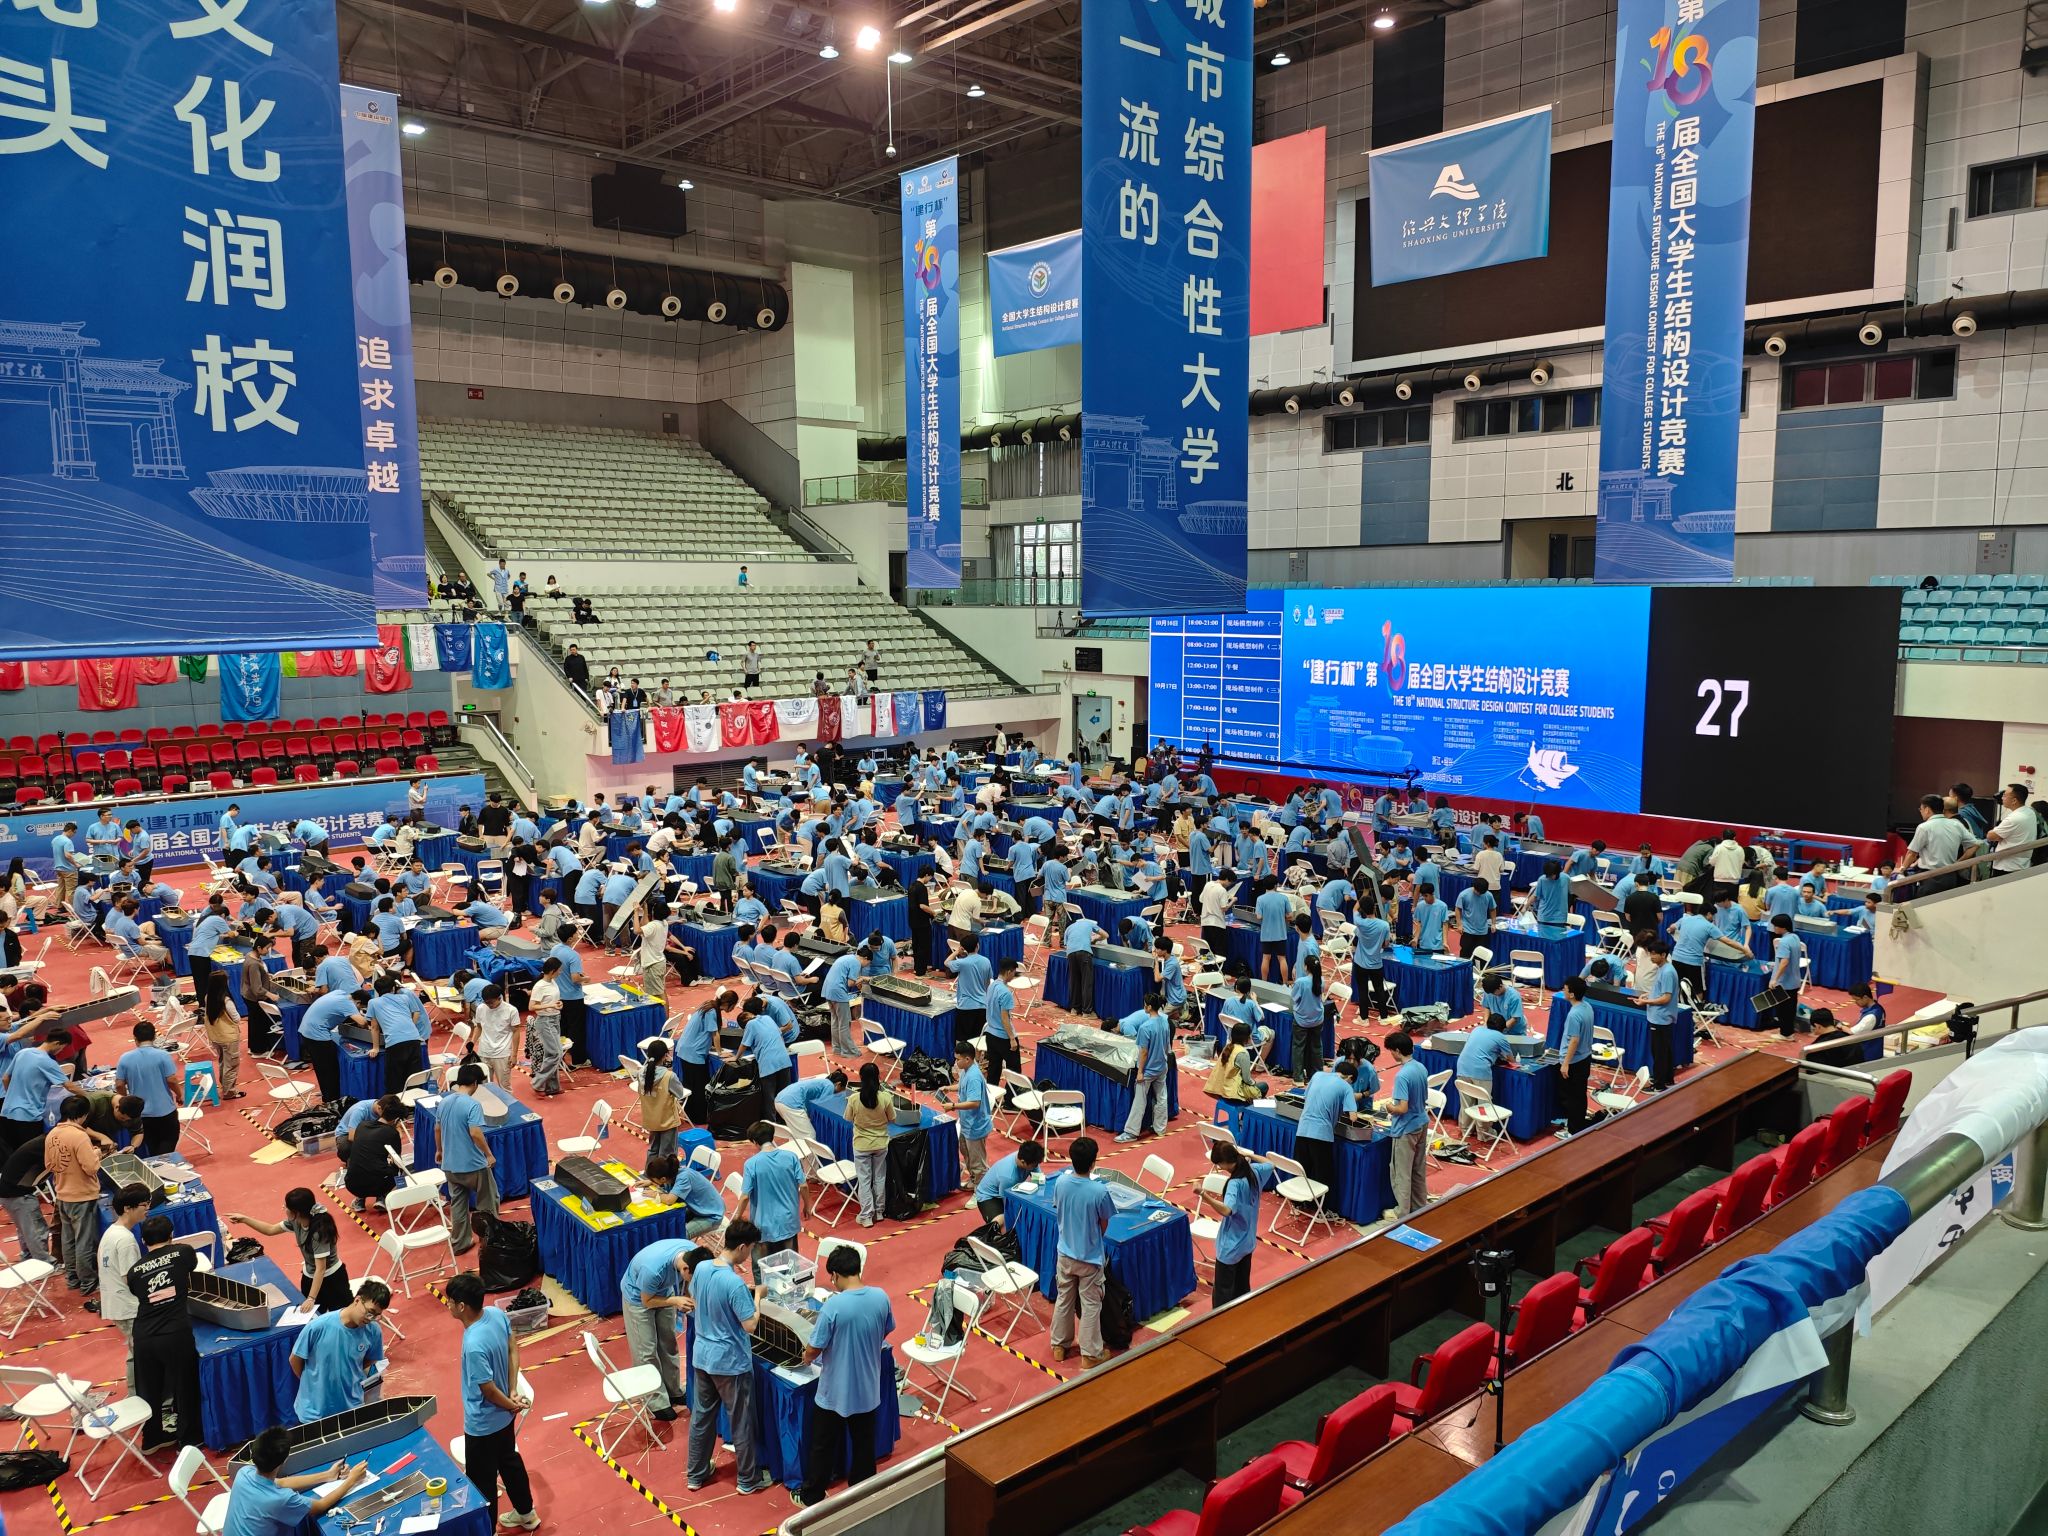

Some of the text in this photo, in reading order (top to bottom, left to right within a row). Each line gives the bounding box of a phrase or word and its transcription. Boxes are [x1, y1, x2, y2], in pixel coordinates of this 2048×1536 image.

[0, 0, 110, 170] 头
[1656, 121, 1666, 142] THE
[1653, 163, 1664, 213] NATIONAL
[910, 196, 949, 217] “建行杯”
[1402, 220, 1508, 248] SHAOXING UNIVERSITY
[1650, 215, 1661, 271] STRUCTURE
[1648, 273, 1659, 309] DESIGN
[1656, 115, 1701, 477] 届全国大学生结构设计竞赛
[1002, 298, 1079, 324] 全国大学生结构设计竞赛
[1647, 310, 1657, 353] CONTEST
[1646, 355, 1656, 375] FOR
[1644, 377, 1655, 419] COLLEGE
[357, 335, 400, 495] 追求卓越
[1641, 420, 1652, 470] STUDENTS
[1556, 472, 1574, 491] 北
[1186, 641, 1218, 649] 08:00-12:00
[1187, 662, 1218, 670] 12:00-13:00
[1154, 682, 1178, 690] 10月17日
[1408, 663, 1570, 698] 届全国大学生结构设计竞赛
[1393, 694, 1404, 706] THE
[1416, 696, 1444, 709] NATIONAL
[1446, 698, 1480, 711] STRUCTURE
[1481, 700, 1503, 713] DESIGN
[1505, 702, 1533, 715] CONTEST
[1534, 703, 1548, 715] FOR
[1549, 704, 1578, 717] COLLEGE
[1579, 706, 1615, 720] STUDENTS
[1695, 679, 1750, 738] 27
[1186, 725, 1217, 733] 18:00-21:00
[136, 810, 224, 830] “建行杯”
[165, 848, 199, 859] NATIONAL
[331, 831, 362, 840] STUDENTS
[133, 1251, 181, 1273] KNOW YOUR
[142, 1259, 171, 1273] POWER
